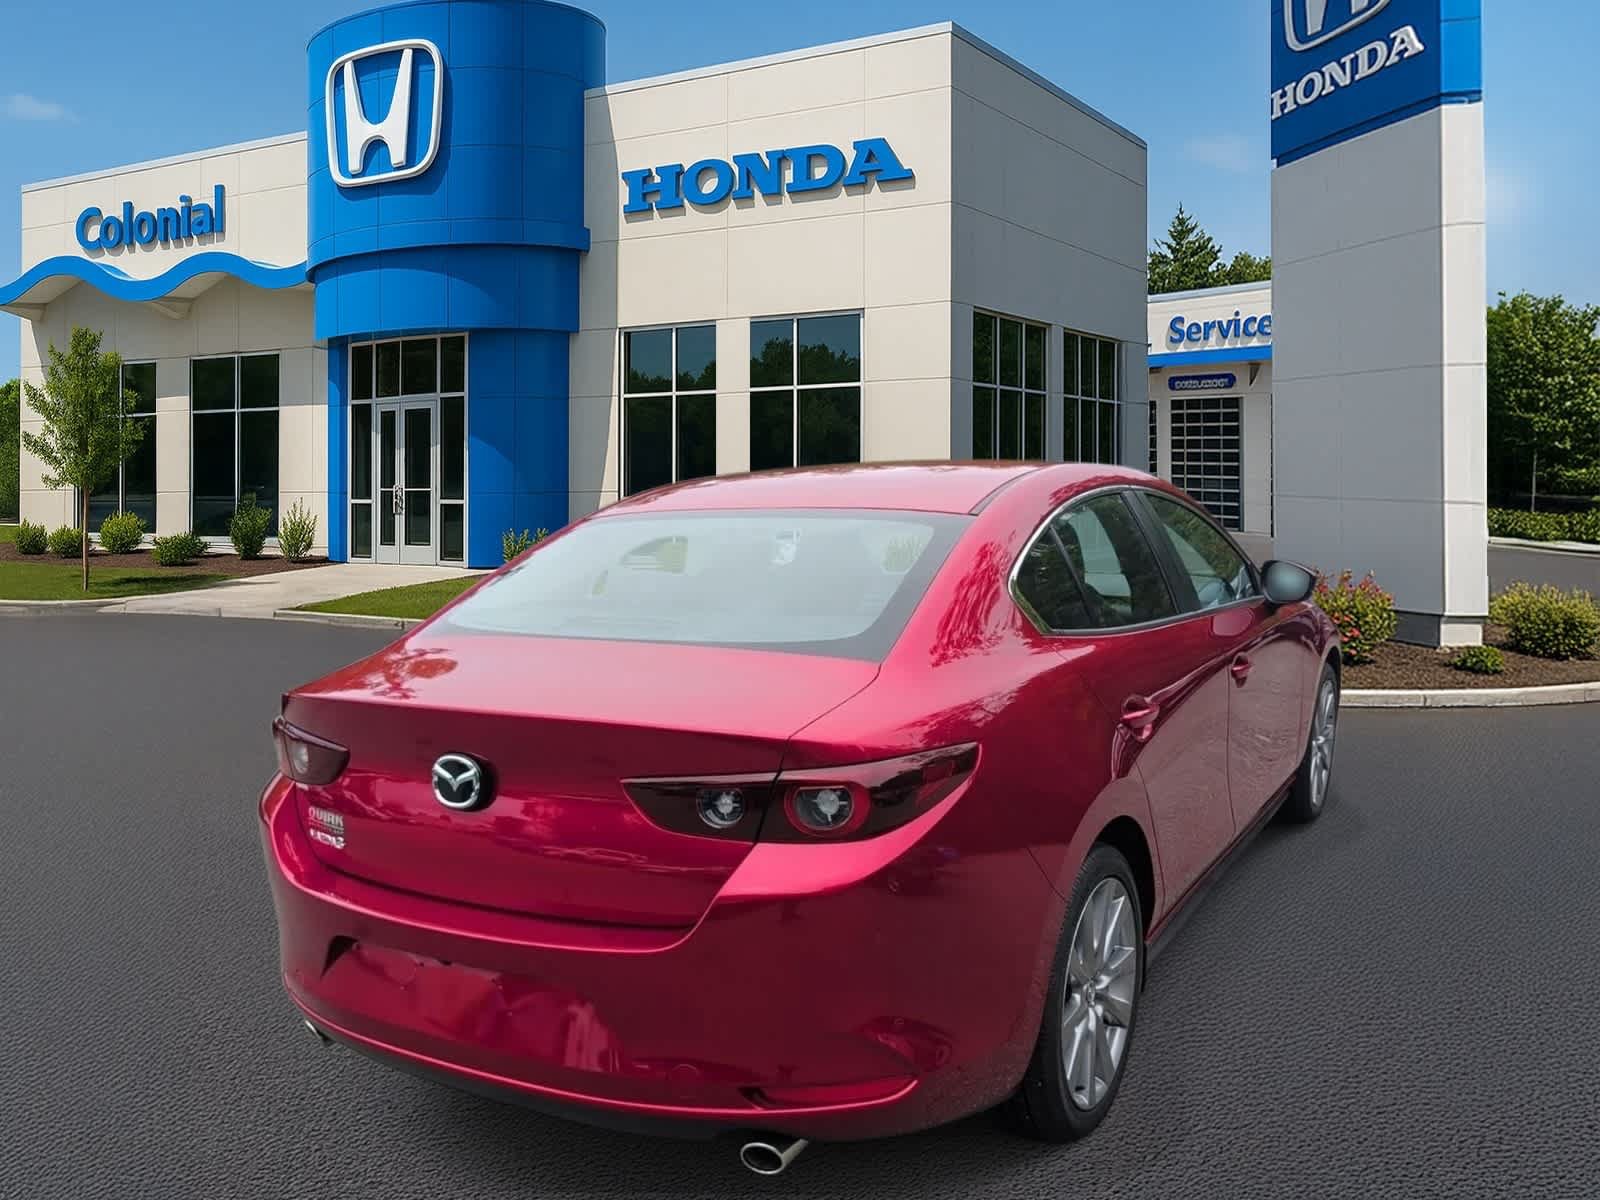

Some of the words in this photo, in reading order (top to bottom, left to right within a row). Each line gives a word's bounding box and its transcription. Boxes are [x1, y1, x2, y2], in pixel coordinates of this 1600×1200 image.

[1271, 25, 1424, 120] HONDA
[622, 137, 913, 213] HONDA
[76, 184, 226, 249] Colonial
[1169, 310, 1272, 344] Service
